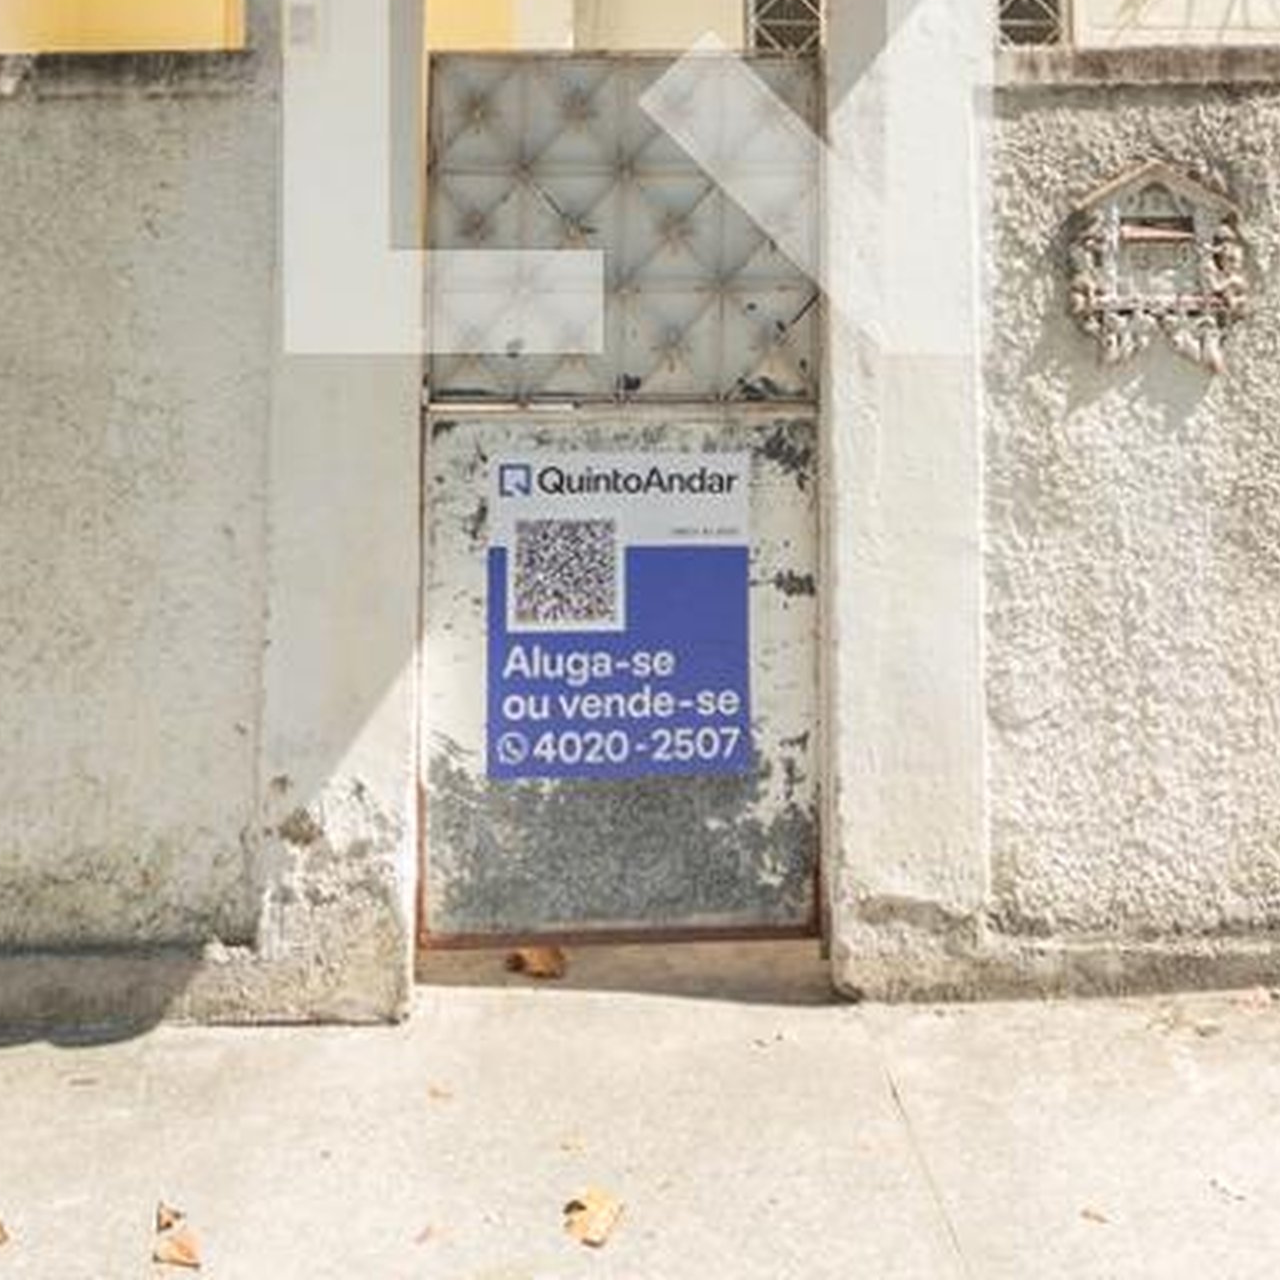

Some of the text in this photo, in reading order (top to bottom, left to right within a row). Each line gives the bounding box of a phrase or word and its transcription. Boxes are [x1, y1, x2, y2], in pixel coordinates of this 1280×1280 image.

[537, 466, 738, 495] QuintoAndar
[503, 646, 674, 685] Aluga-se
[503, 686, 740, 720] ou vende-se
